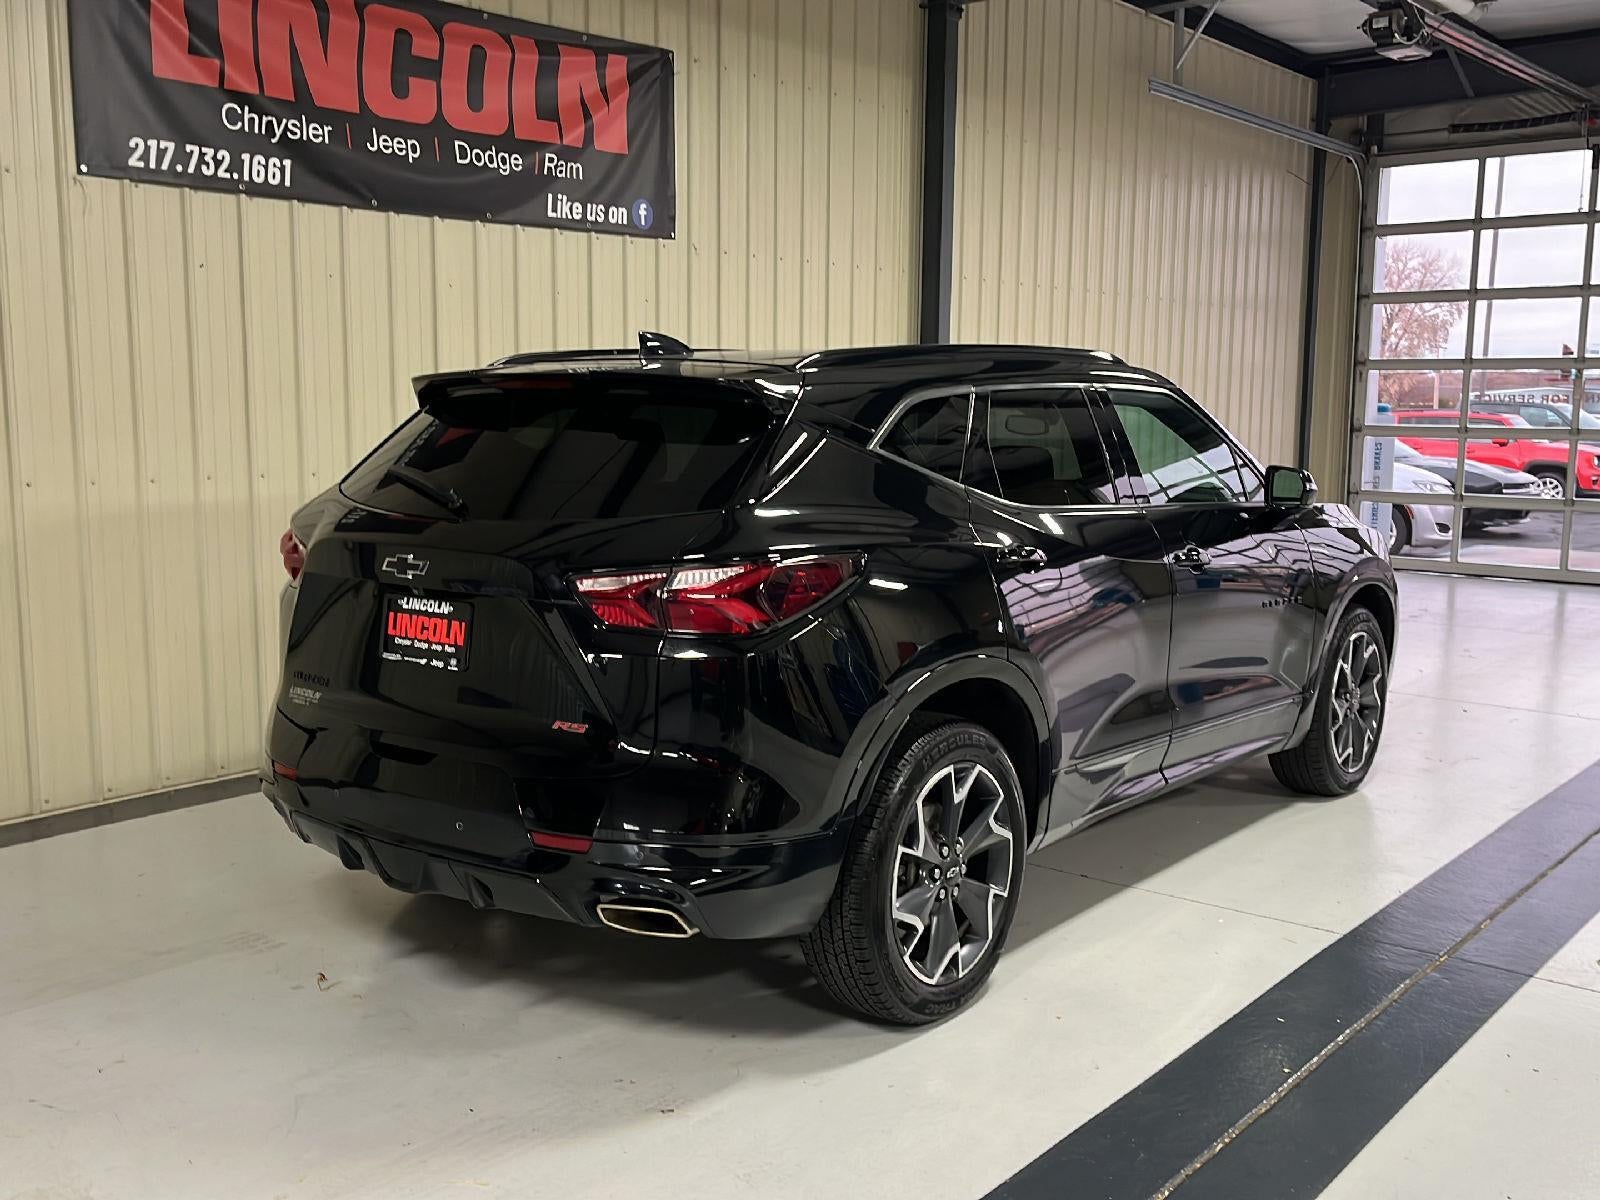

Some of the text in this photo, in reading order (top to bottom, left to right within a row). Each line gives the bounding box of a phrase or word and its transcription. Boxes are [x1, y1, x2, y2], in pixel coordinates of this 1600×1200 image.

[150, 0, 629, 154] LINCOLN
[127, 136, 293, 188] 217.732.1661
[222, 102, 583, 180] Chrysler Jeep Dodge Ram
[547, 193, 582, 221] Like
[586, 203, 605, 223] us
[608, 206, 628, 225] on
[402, 597, 450, 614] LINCOLN
[387, 611, 465, 647] LINCOLN
